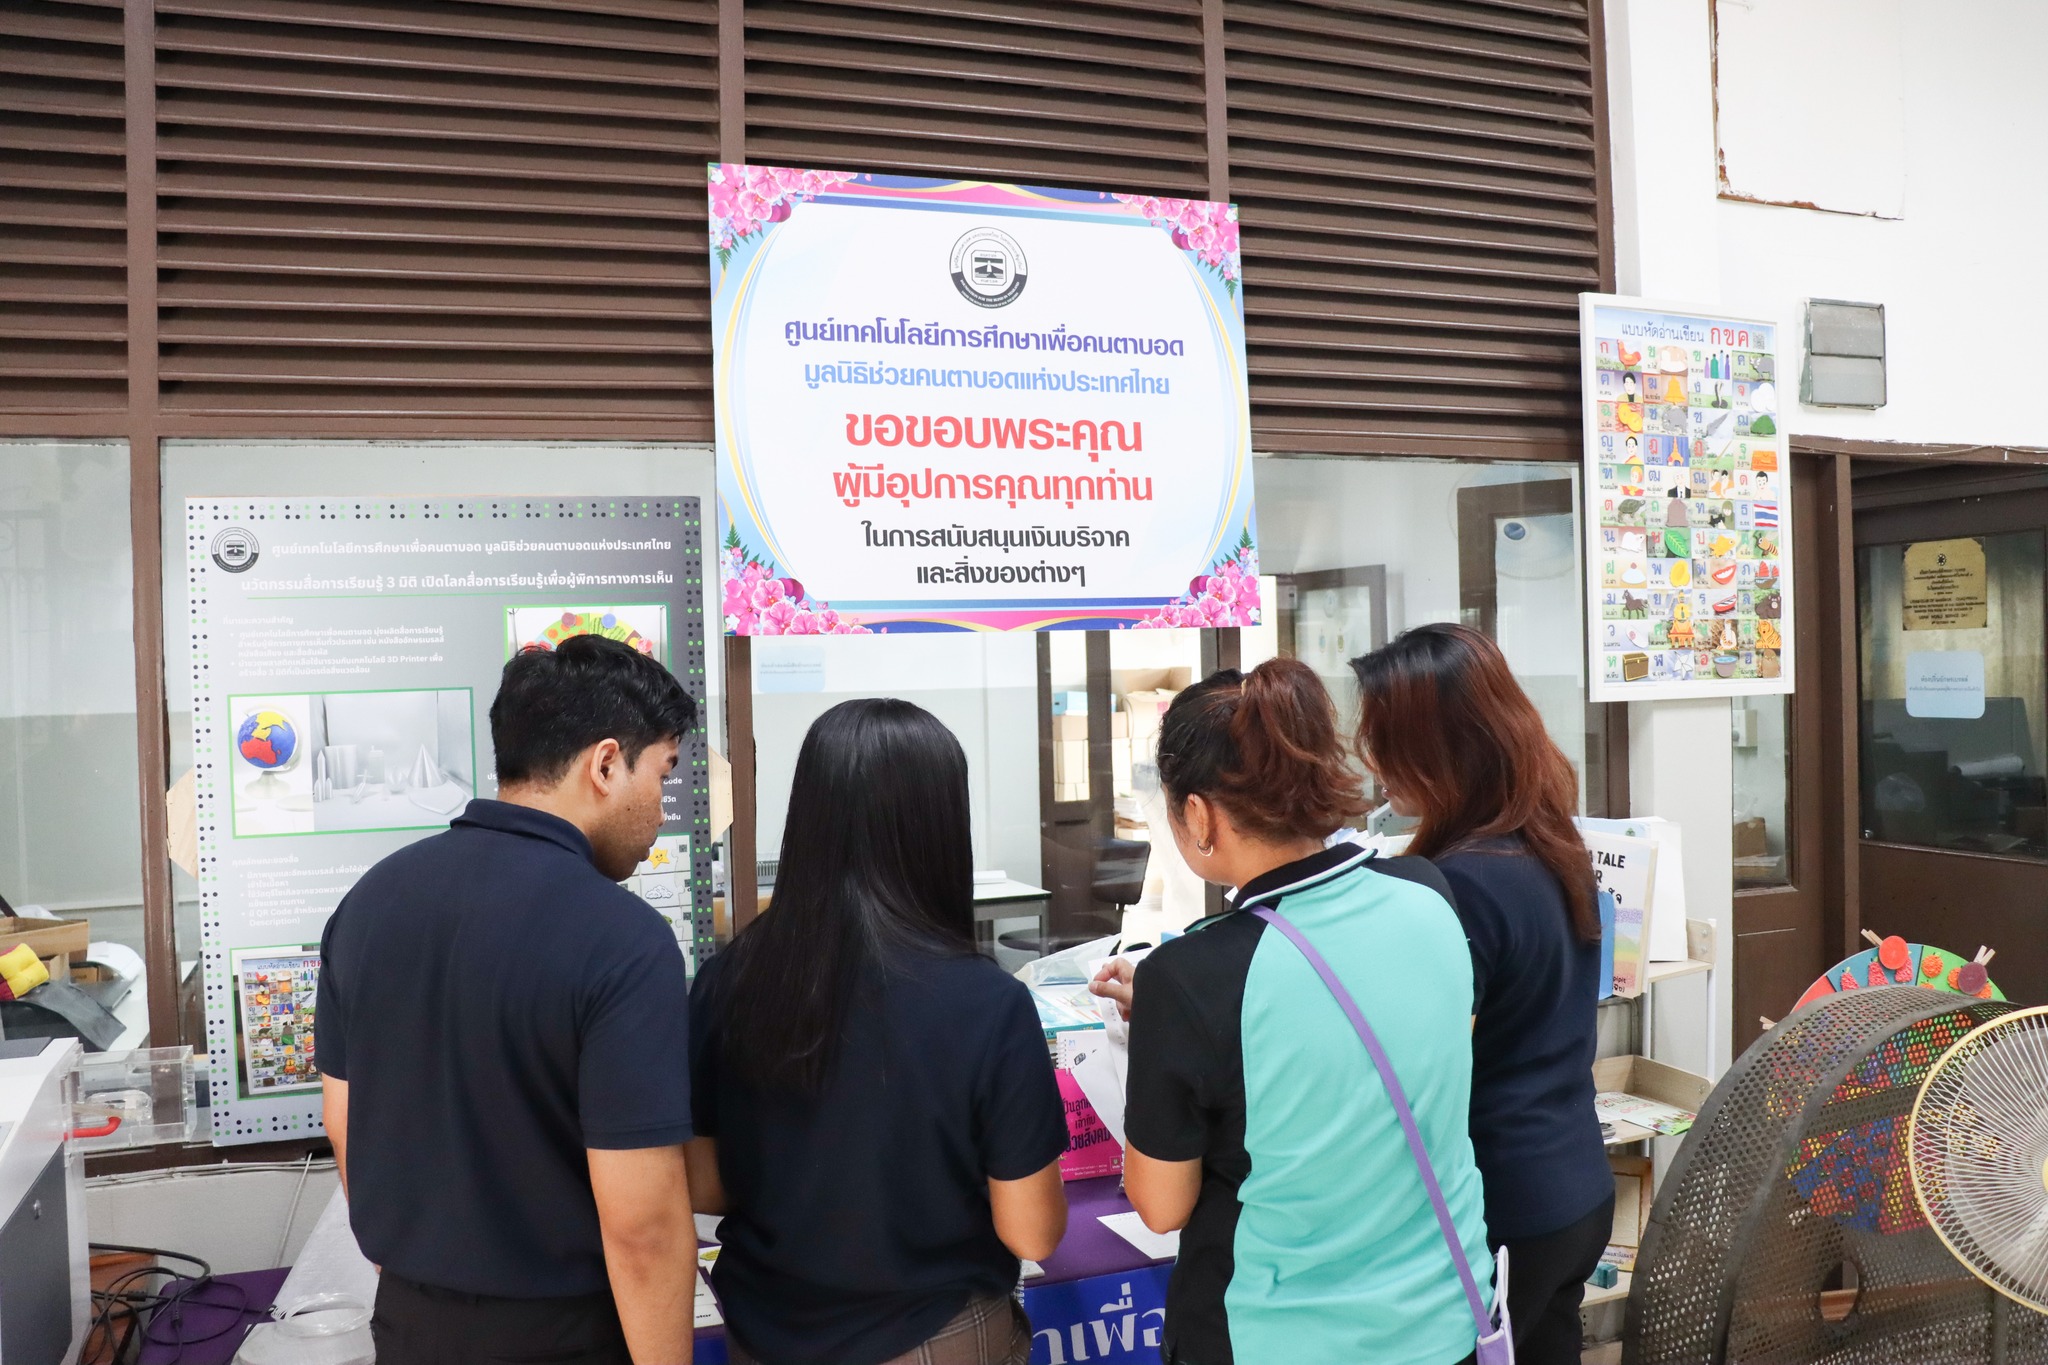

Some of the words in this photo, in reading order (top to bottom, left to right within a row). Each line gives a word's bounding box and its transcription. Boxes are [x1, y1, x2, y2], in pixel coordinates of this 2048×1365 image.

[784, 316, 1185, 357] ศูนย์เทคโนโลยีการศึกษาเพื่อคนตาบอด
[1621, 320, 1705, 343] แบบหัดอ่านเขียน
[804, 360, 1170, 396] มูลนิธิช่วยคนตาบอดแห่งประเทศไทย
[845, 412, 1143, 462] ขอขอบพระคุณ
[832, 463, 1154, 509] ผู้มีอุปการคุณทุกท่าน
[271, 538, 482, 558] ศูนย์เทคโนโลยีการศึกษาเพื่อคนตาบอด
[484, 538, 672, 555] มูลนิธิช่วยคนตาบอดแห่งประเทศไทย
[861, 520, 1130, 553] ในการสนับสนุนเงินบริจาค
[241, 573, 384, 592] นวัตกรรมสื่อการเรียนรู้
[386, 576, 396, 588] 3
[398, 575, 418, 589] มิติ
[421, 569, 674, 589] เปิดโลกสื่อการเรียนรู้เพื่อผู้พิการทางการเห็น
[916, 555, 1086, 587] และสิ่งของต่างๆ
[386, 655, 399, 663] 3D
[399, 655, 428, 663] Printer
[1597, 850, 1626, 869] TALE
[256, 908, 269, 917] QR
[270, 907, 293, 916] Code
[1032, 1281, 1167, 1365] าเพื่อ
